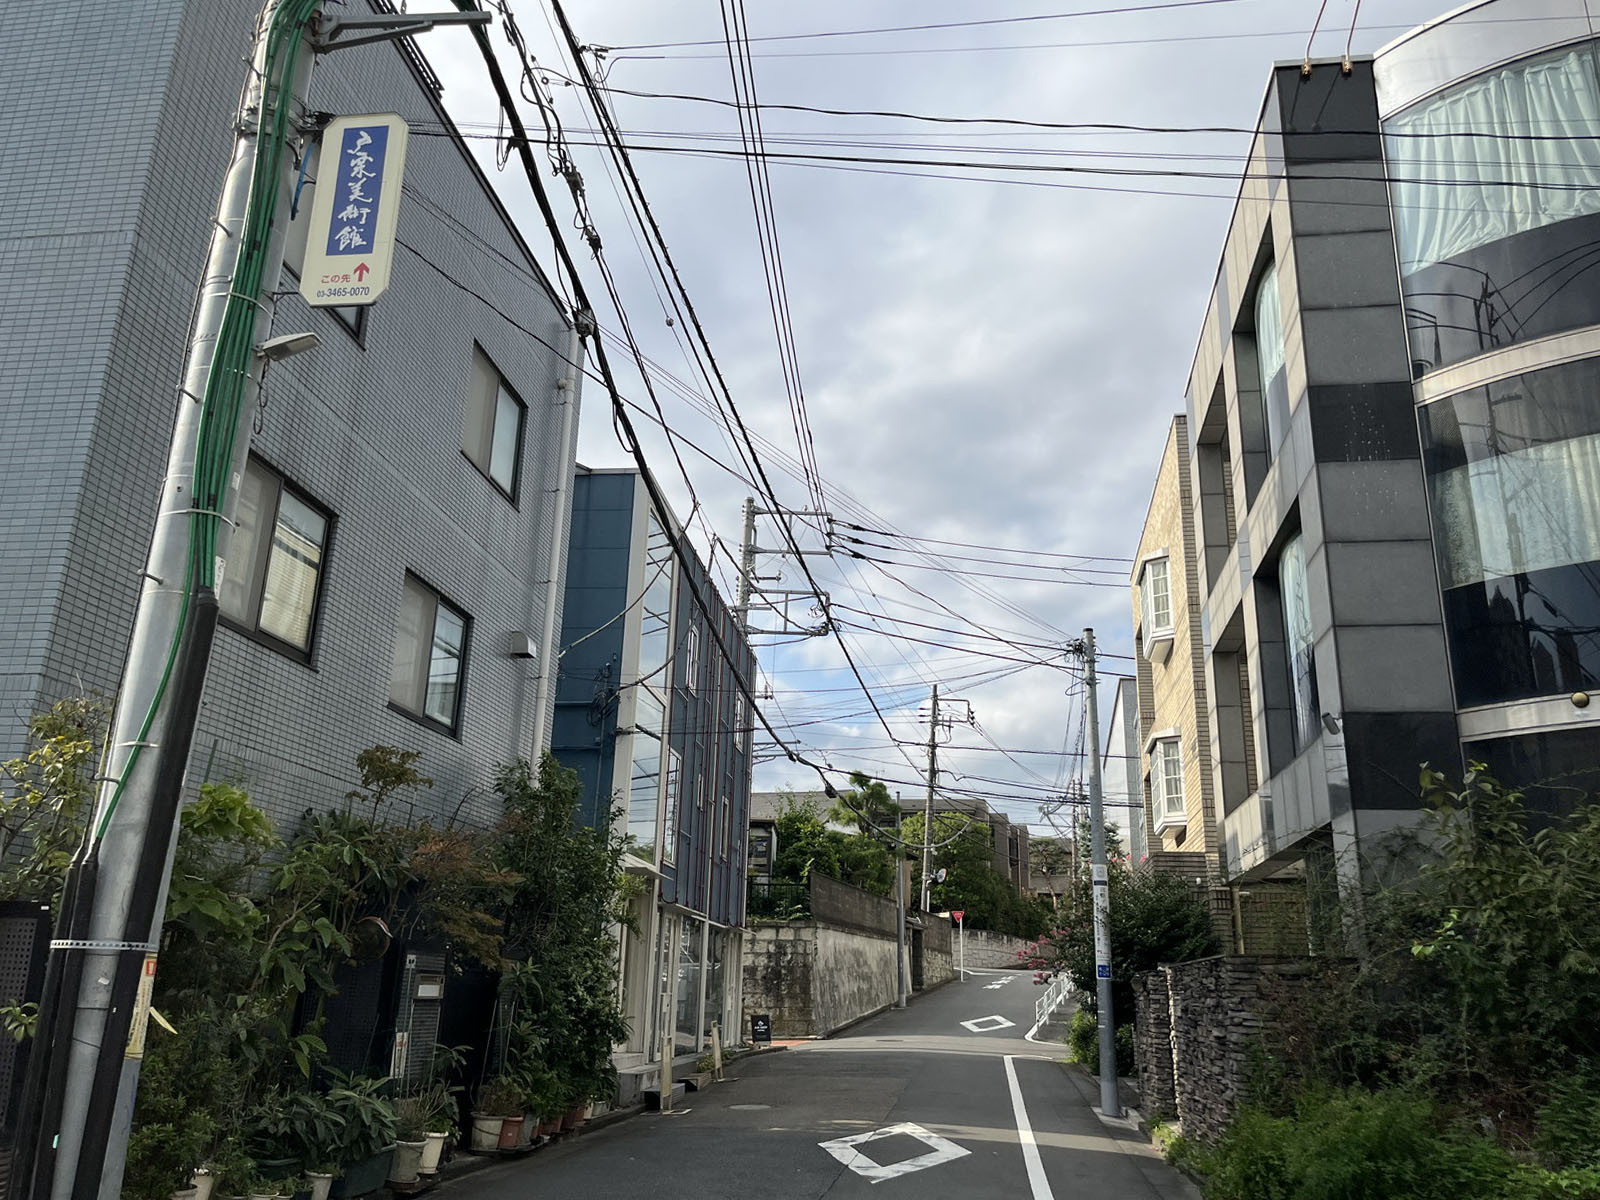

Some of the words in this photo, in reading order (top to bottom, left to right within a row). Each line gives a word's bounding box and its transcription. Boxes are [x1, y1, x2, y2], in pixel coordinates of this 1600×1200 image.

[321, 274, 351, 284] この先
[316, 286, 370, 298] 03-3465-0070
